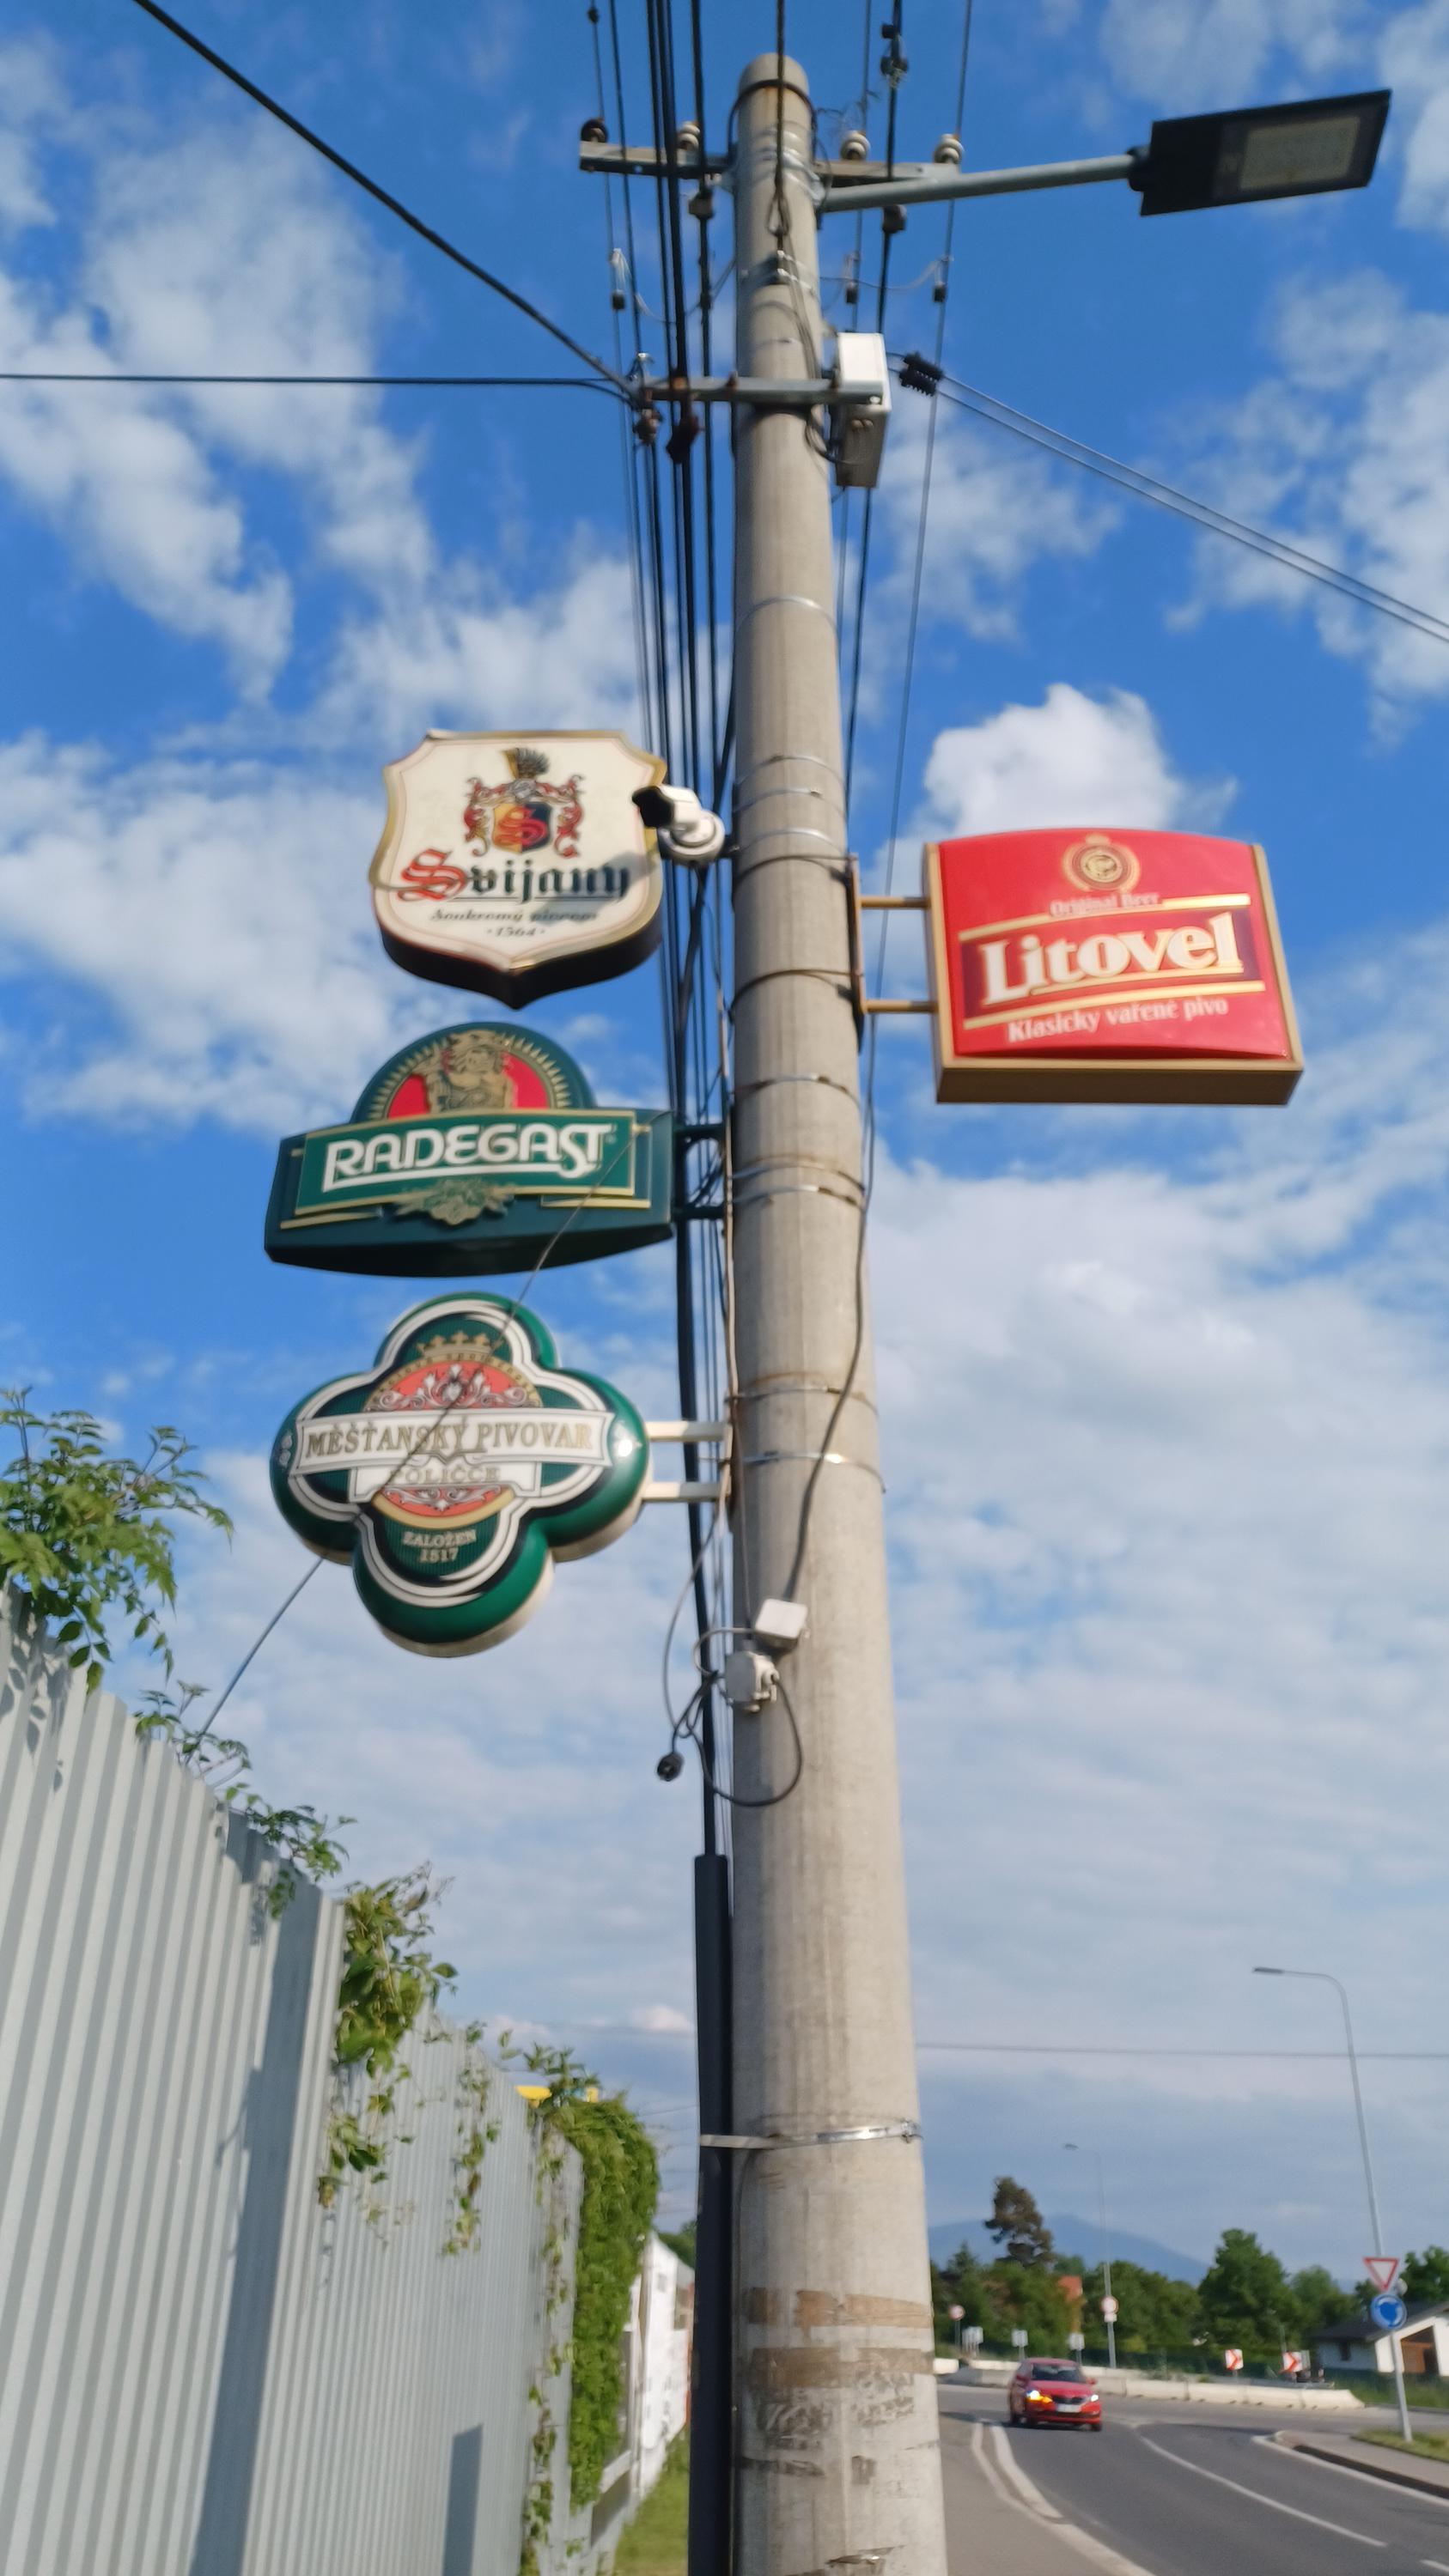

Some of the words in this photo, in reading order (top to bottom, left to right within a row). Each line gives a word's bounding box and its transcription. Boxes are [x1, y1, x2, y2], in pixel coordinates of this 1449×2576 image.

[398, 848, 630, 902] Svijany
[982, 911, 1244, 1005] Litovel
[1008, 1008, 1101, 1042] Klasicky
[1105, 999, 1179, 1026] vařené
[1182, 994, 1229, 1022] pivo
[322, 1123, 615, 1193] RADEGAST
[305, 1417, 469, 1458] MĚŠŤANSKÝ
[477, 1422, 593, 1453] PIVOVAR
